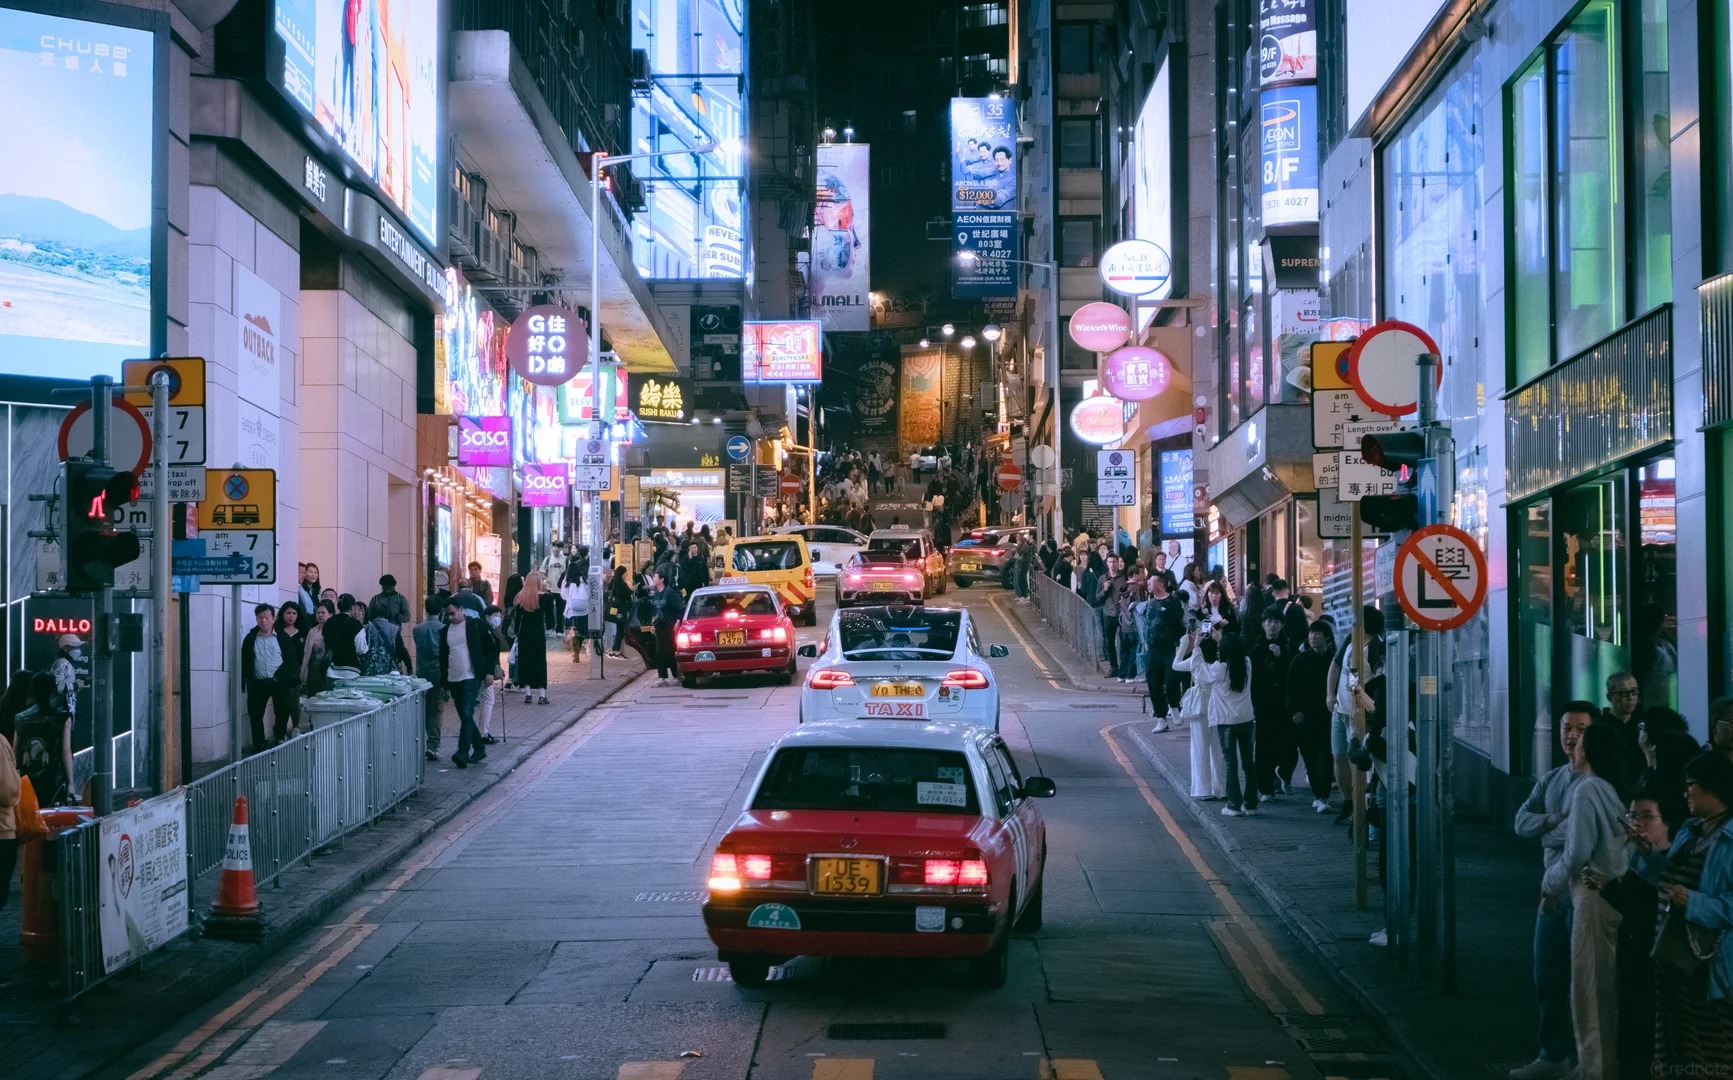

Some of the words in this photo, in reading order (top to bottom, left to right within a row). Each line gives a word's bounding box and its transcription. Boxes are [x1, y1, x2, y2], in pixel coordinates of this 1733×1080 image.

[40, 35, 127, 59] CHUBB
[1264, 157, 1299, 184] 8/F
[959, 191, 993, 201] $12,000
[1285, 197, 1309, 206] 4027
[990, 250, 1011, 258] 4027
[1123, 254, 1148, 262] NCB
[1075, 324, 1108, 332] Watson's
[639, 407, 658, 416] SUSHI
[659, 409, 677, 417] RAKU
[1330, 402, 1354, 413] 上午
[176, 411, 189, 429] 7
[1347, 426, 1375, 434] Length
[176, 441, 189, 459] 7
[598, 468, 604, 476] 7
[599, 481, 608, 489] 12
[1121, 481, 1127, 489] 7
[1122, 495, 1133, 503] 12
[212, 541, 233, 551] 上午
[246, 534, 258, 550] 7
[865, 703, 923, 716] TAXI
[836, 862, 860, 877] UE
[824, 877, 870, 893] 1539
[768, 910, 779, 921] 4
